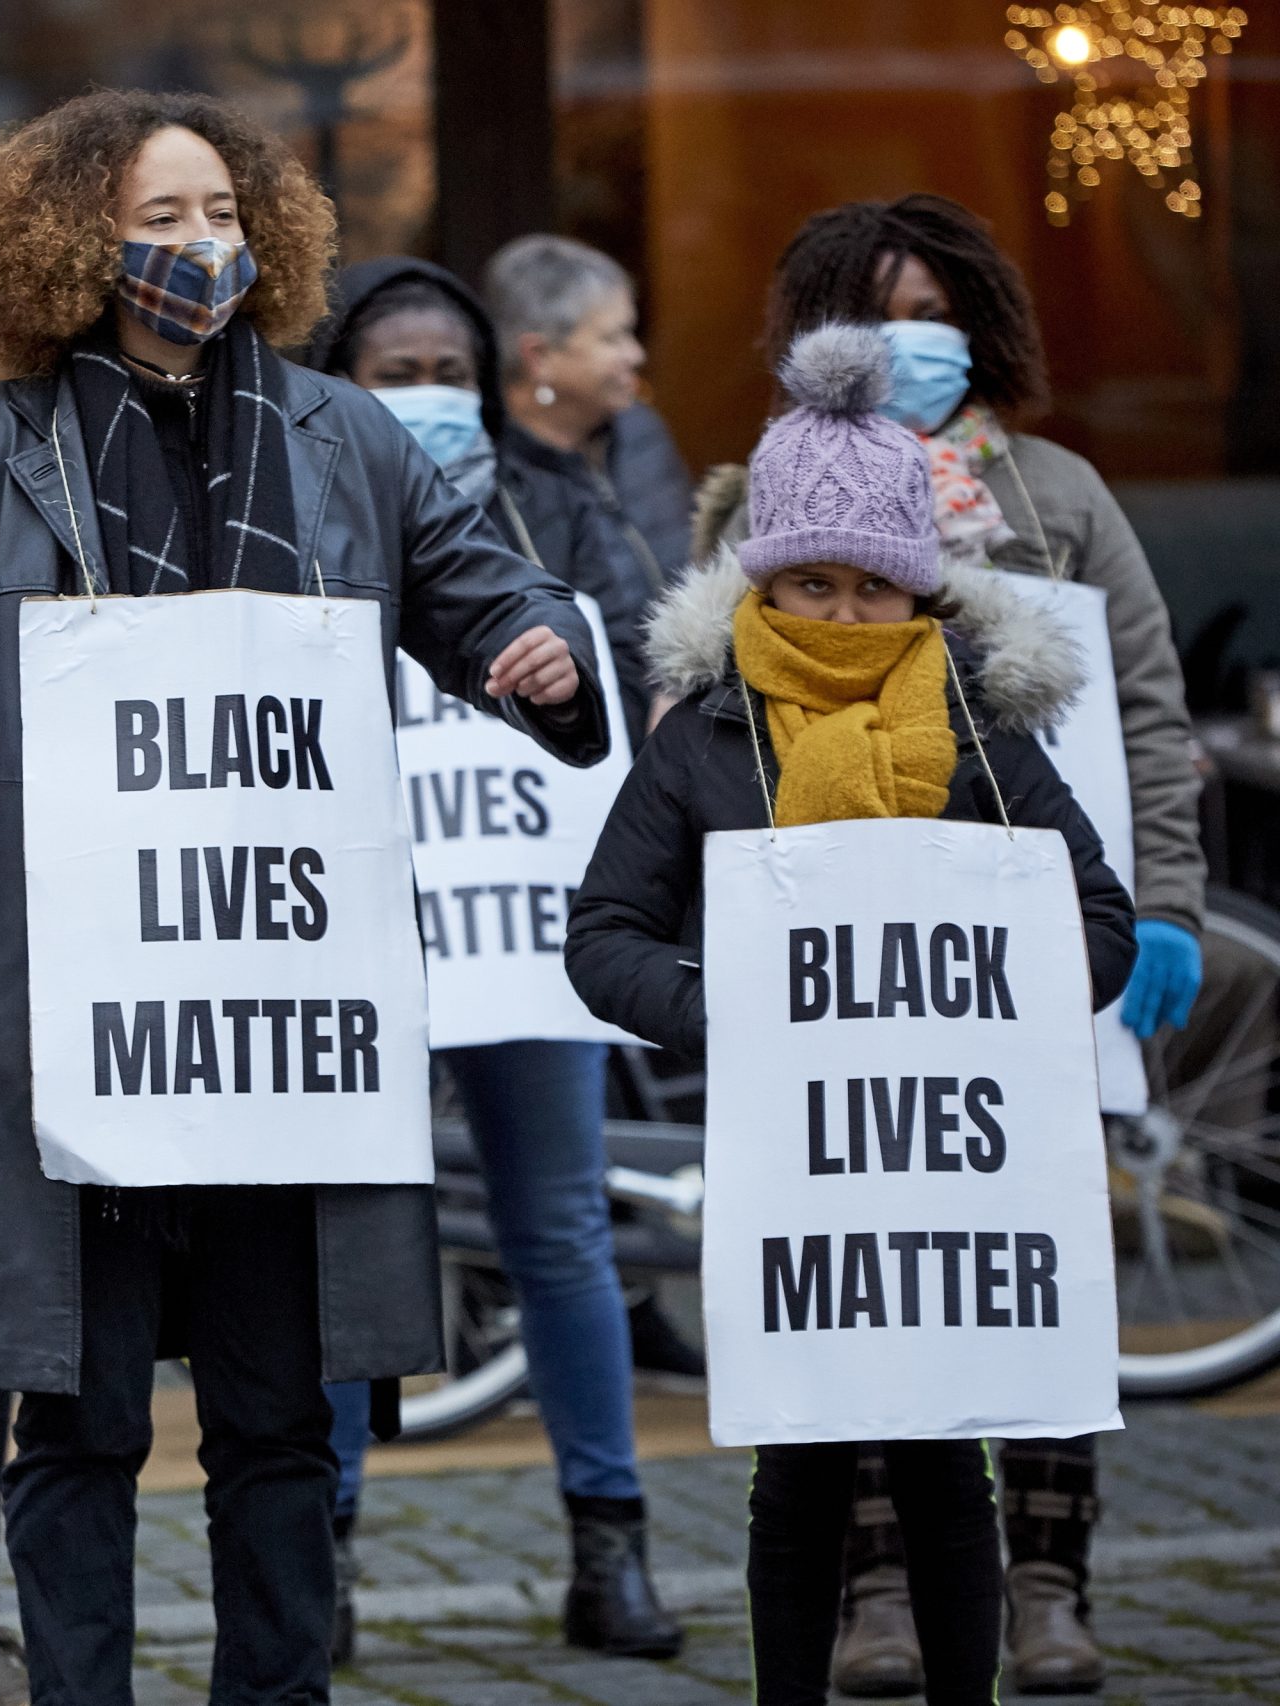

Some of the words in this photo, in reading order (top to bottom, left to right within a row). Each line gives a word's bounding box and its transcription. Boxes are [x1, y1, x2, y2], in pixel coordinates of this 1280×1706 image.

[115, 694, 334, 792] BLACK
[409, 769, 550, 843] IVES
[137, 846, 329, 943] LIVES
[419, 884, 581, 960] ATTE
[789, 922, 1018, 1024] BLACK
[92, 999, 381, 1097] MATTER
[807, 1076, 1007, 1176] LIVES
[762, 1231, 1061, 1333] MATTER
